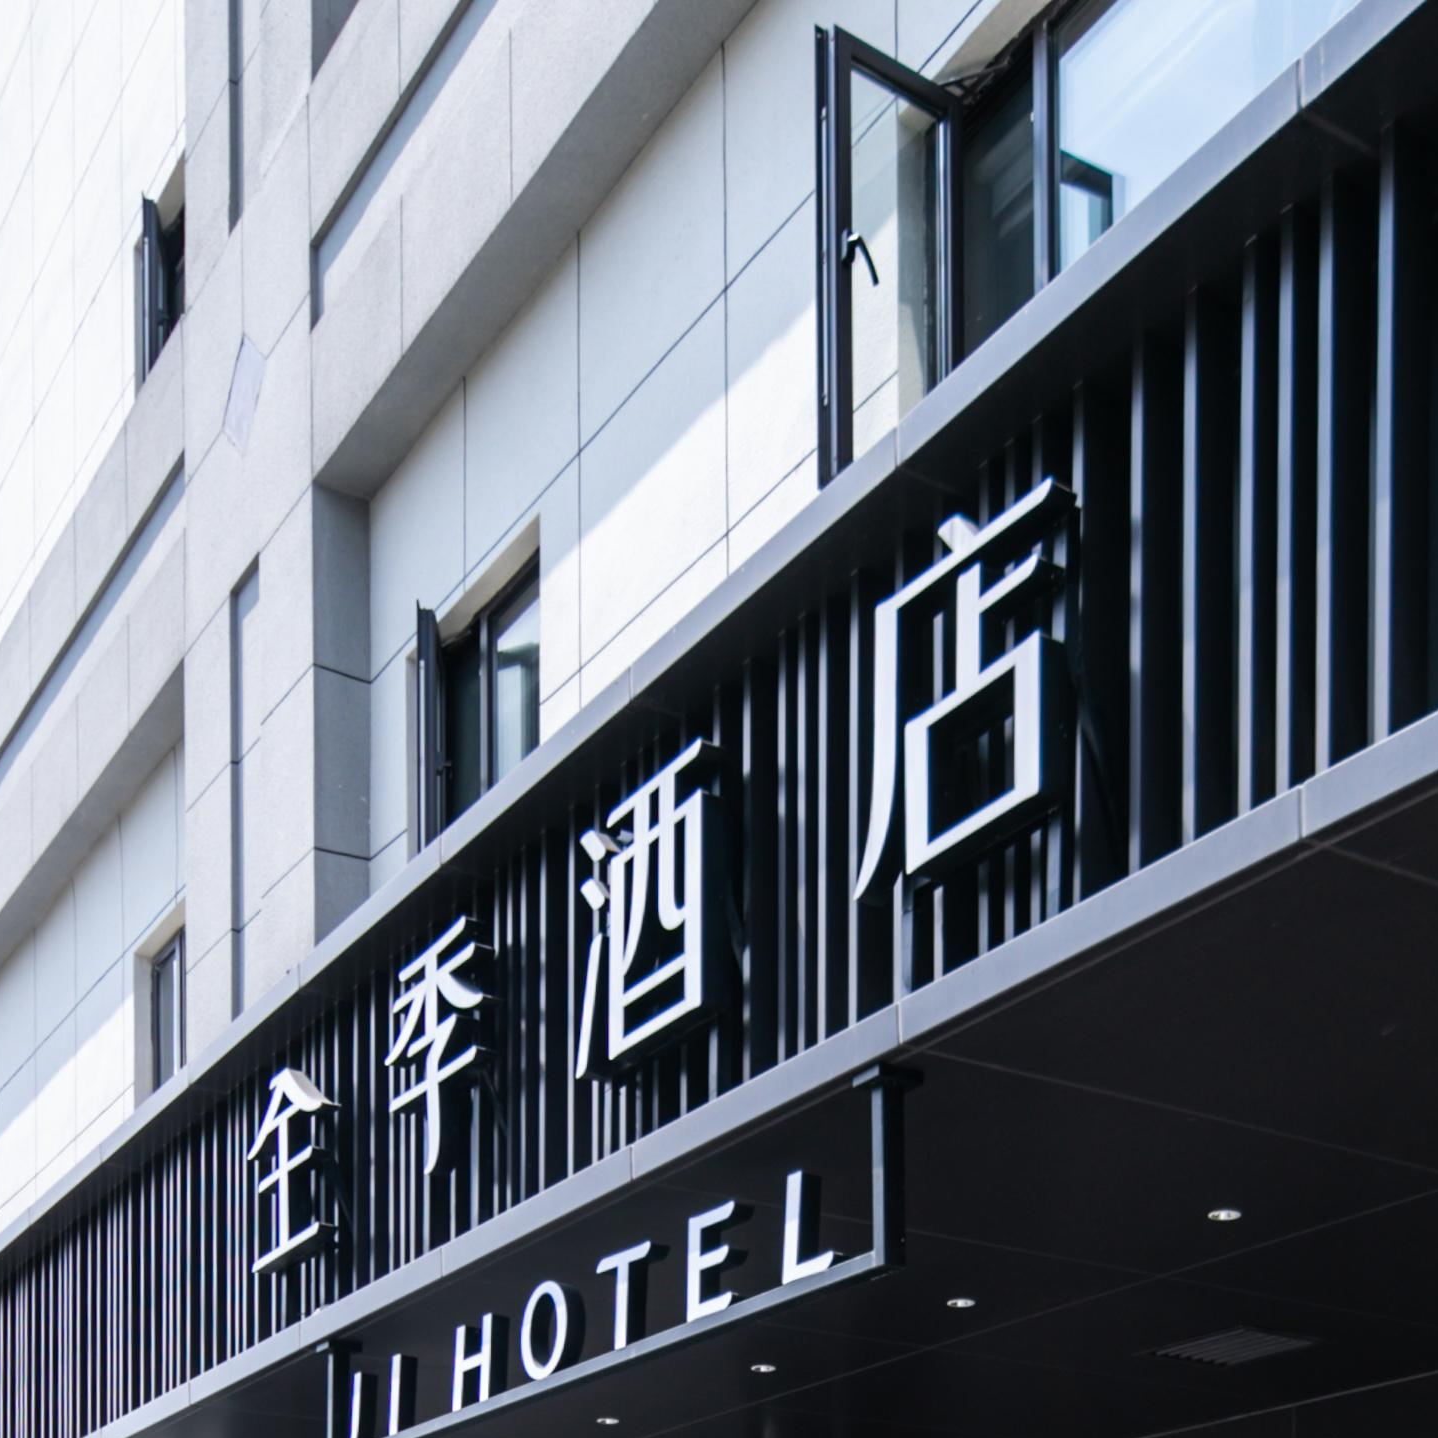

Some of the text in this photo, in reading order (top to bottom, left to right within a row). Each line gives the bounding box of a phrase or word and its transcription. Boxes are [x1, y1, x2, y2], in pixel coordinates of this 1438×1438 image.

[247, 477, 1074, 1273] 全季酒店
[451, 1170, 835, 1412] HOTEL
